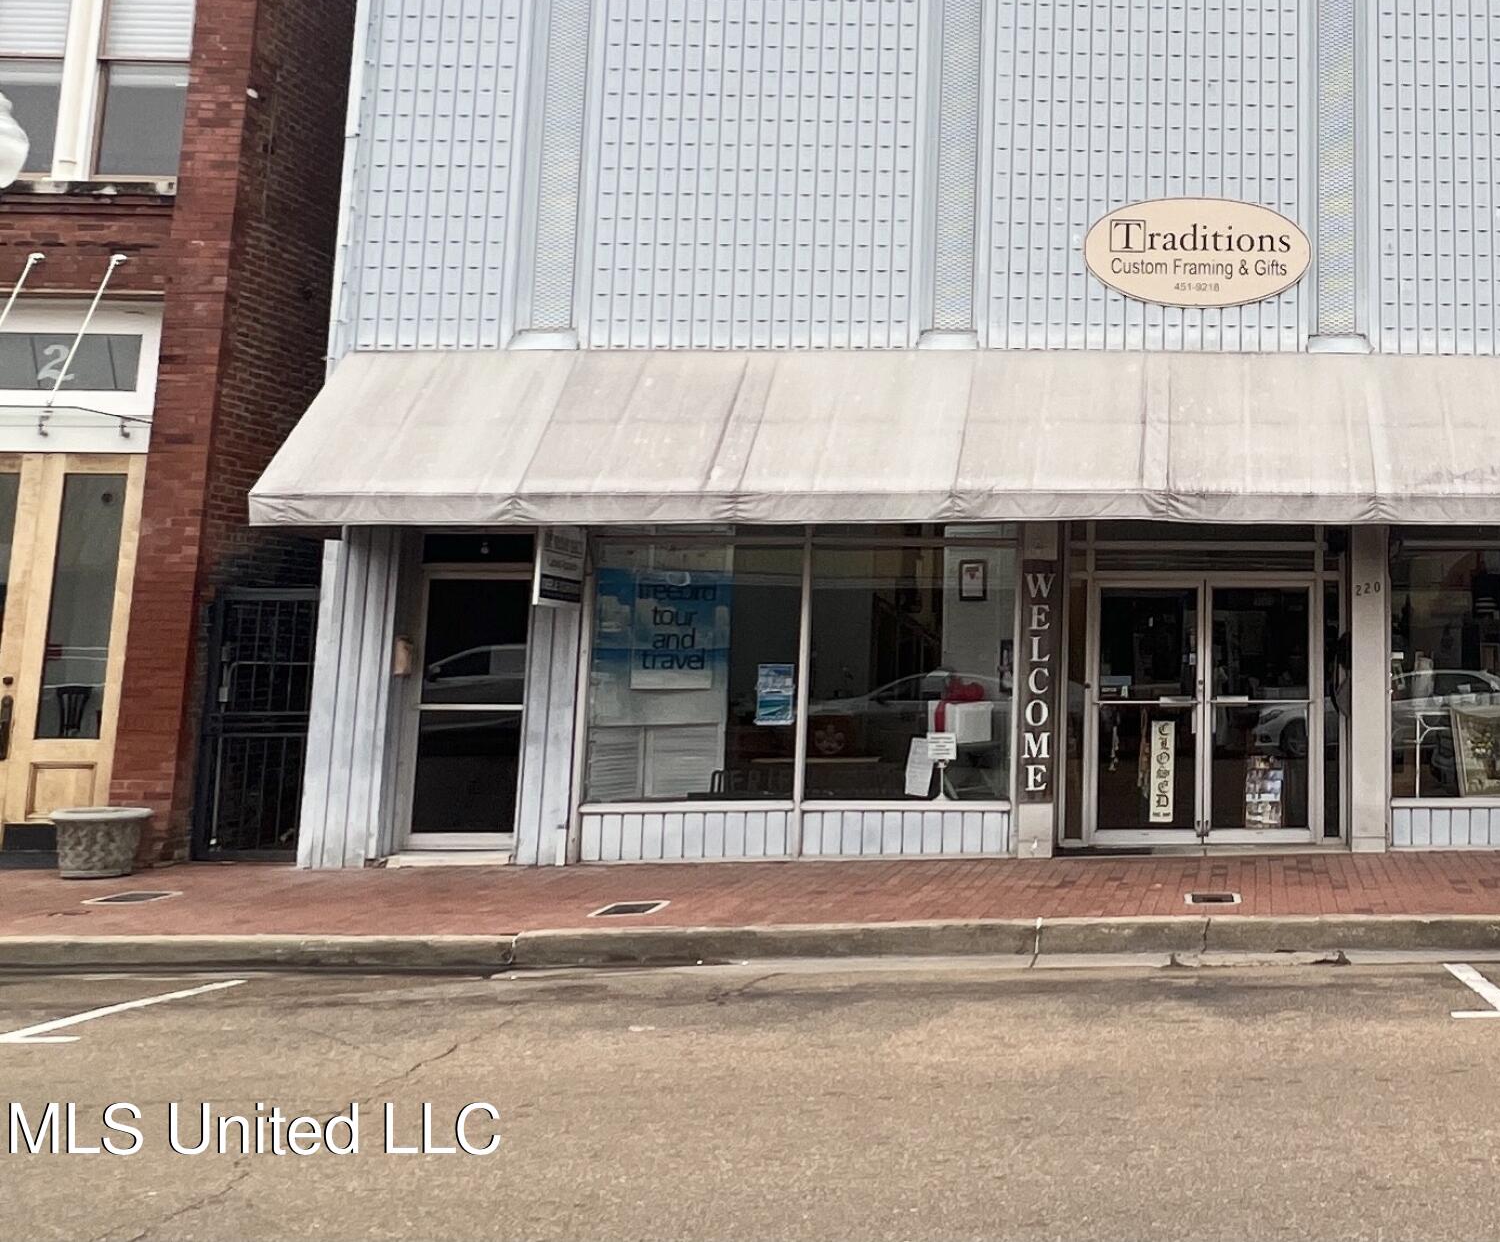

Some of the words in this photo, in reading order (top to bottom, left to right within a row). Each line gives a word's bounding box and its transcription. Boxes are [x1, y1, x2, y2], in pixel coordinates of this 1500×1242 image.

[1110, 219, 1291, 255] Traditions
[1110, 257, 1168, 276] Custom
[1173, 258, 1233, 280] Framing
[1238, 260, 1249, 276] &
[1254, 259, 1288, 277] Gifts
[37, 344, 75, 382] 2
[1354, 580, 1382, 597] 220
[652, 606, 698, 626] tour
[652, 627, 696, 650] and
[640, 648, 705, 670] travel
[1022, 572, 1055, 793] WELCOME
